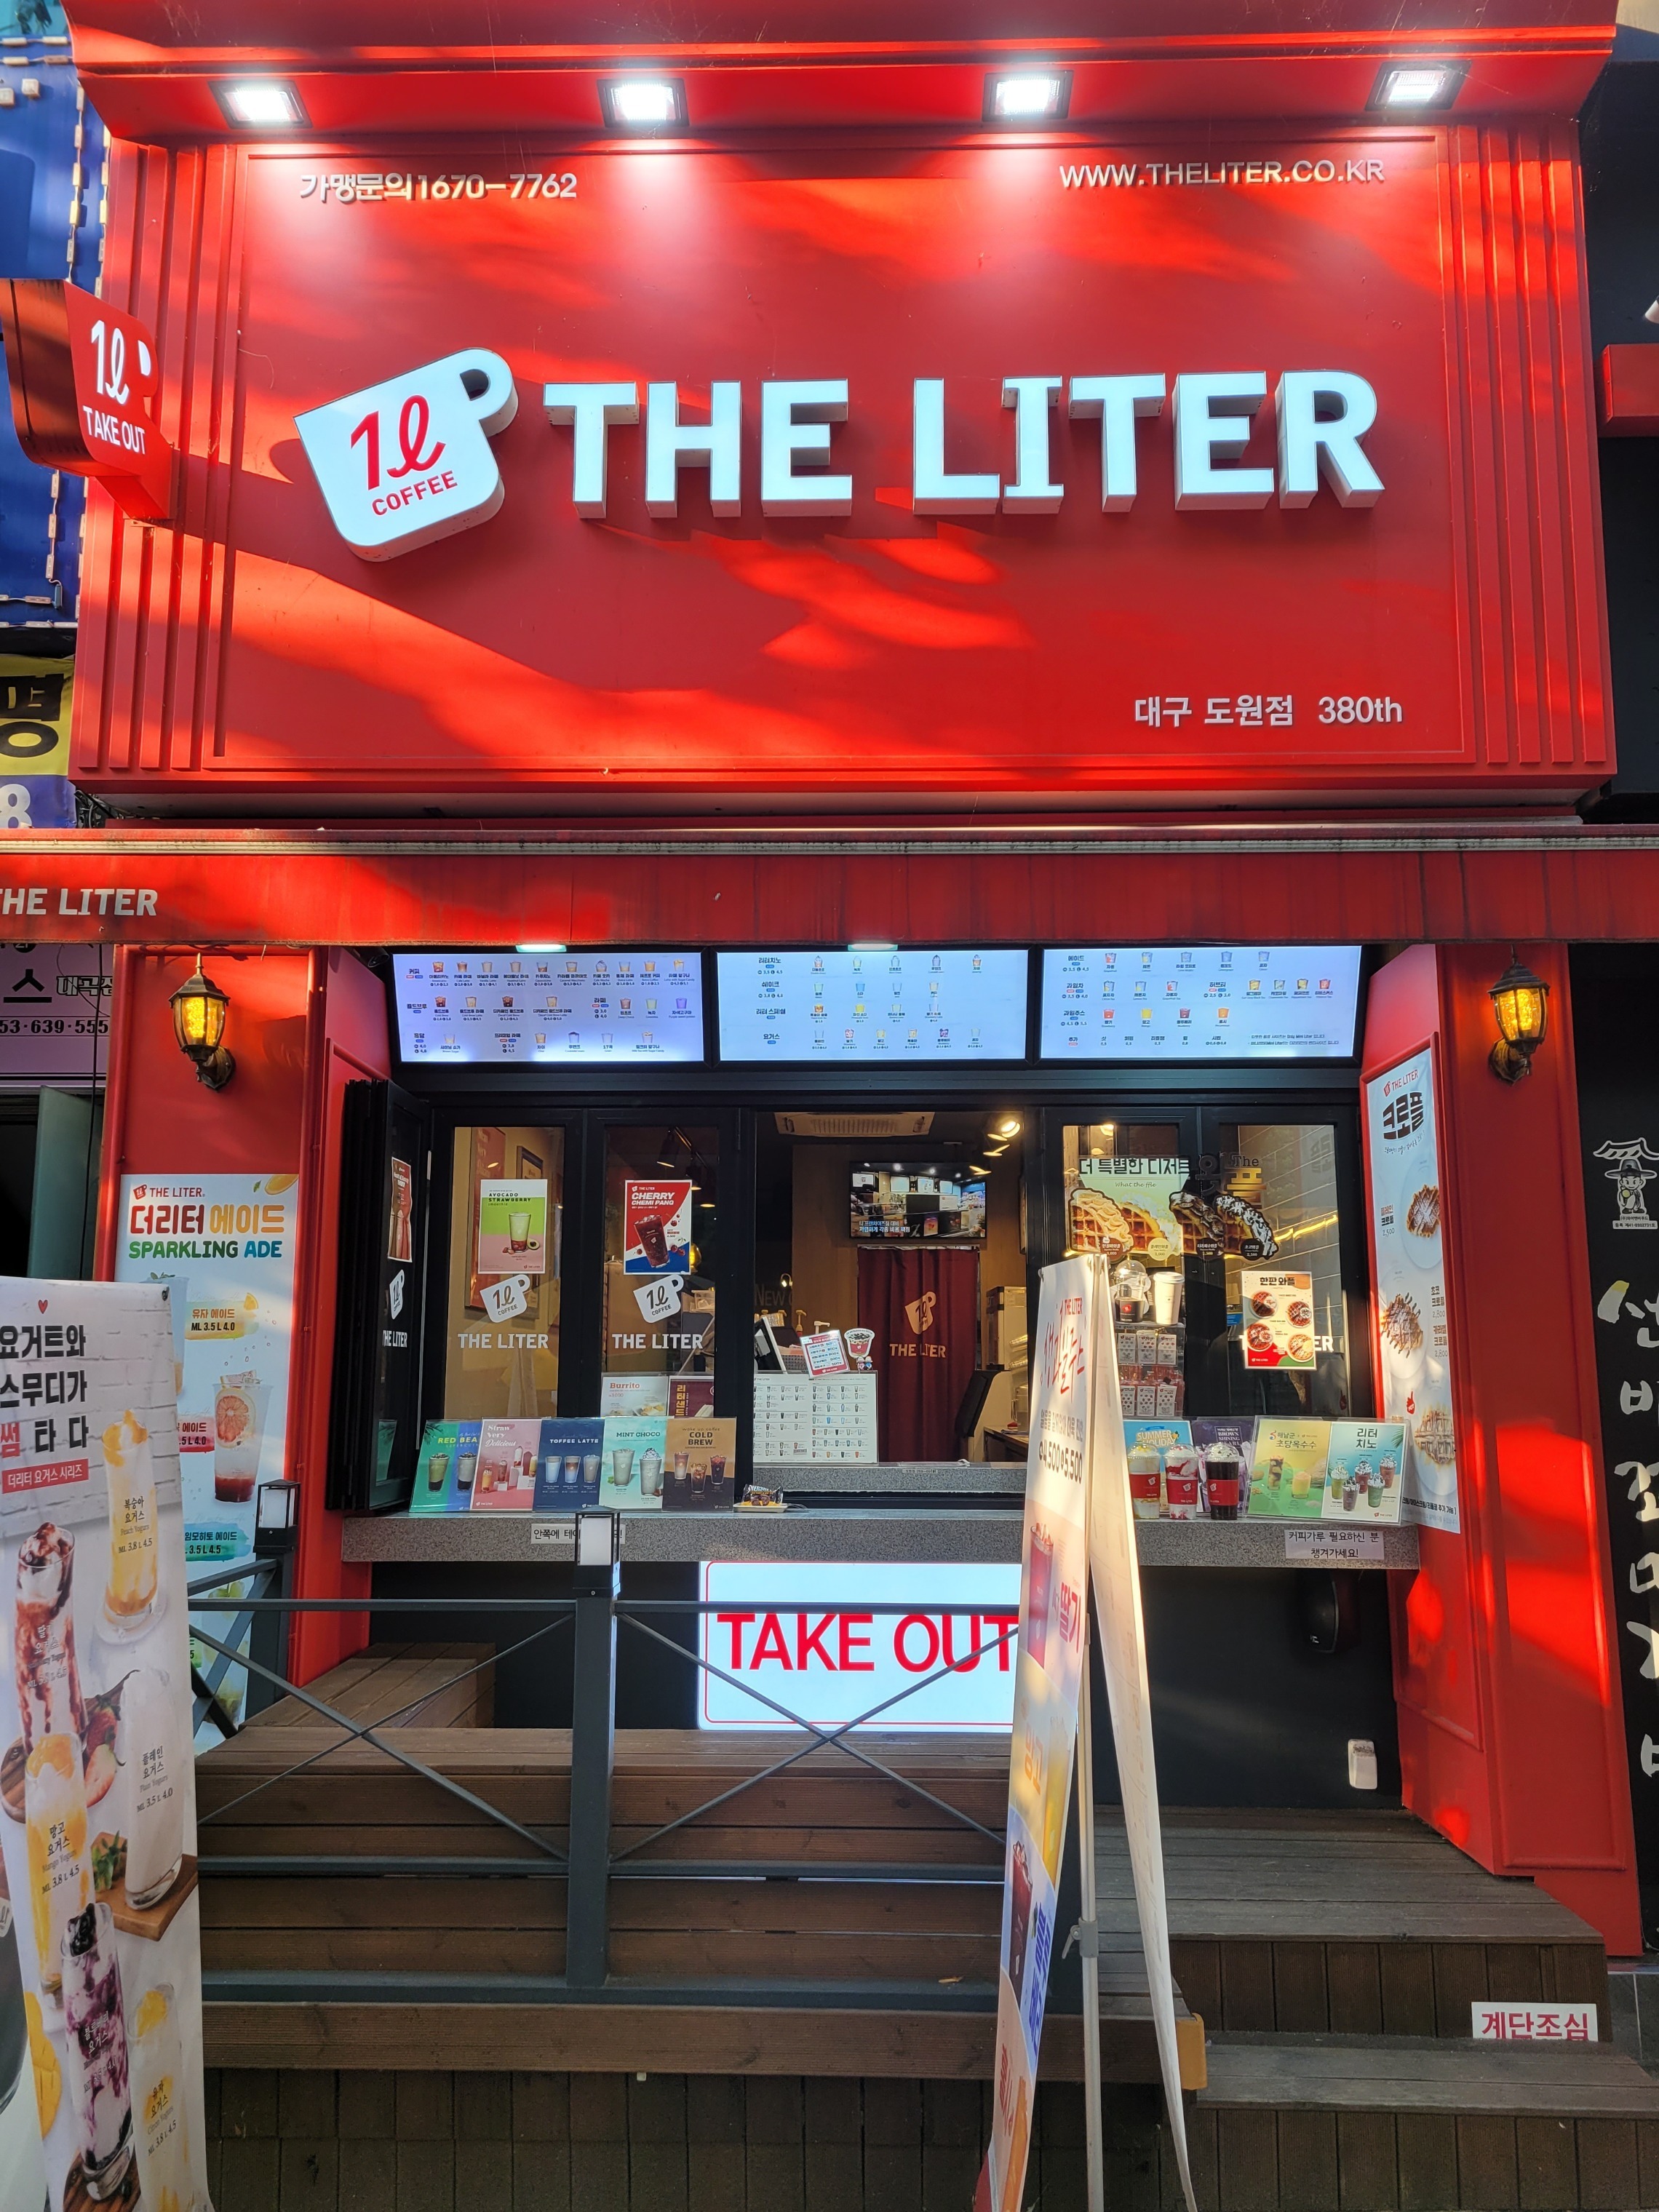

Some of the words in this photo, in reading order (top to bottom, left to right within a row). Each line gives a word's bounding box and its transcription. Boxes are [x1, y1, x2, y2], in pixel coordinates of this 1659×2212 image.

[1059, 159, 1385, 188] WWW.THELITER.CO.KR
[417, 173, 578, 200] 1670-7762
[83, 405, 121, 447] TAKE
[120, 419, 147, 456] OUT
[543, 377, 853, 517] THE
[912, 370, 1385, 514] LITER
[371, 470, 458, 517] COFFEE
[1135, 696, 1193, 728] 대구
[1204, 694, 1294, 727] 도원점
[1318, 696, 1403, 724] 380th
[0, 888, 48, 915] HE
[58, 888, 158, 917] LITER
[3, 968, 52, 1003] 스
[1391, 1078, 1402, 1091] THE
[1403, 1069, 1419, 1086] LITER
[1079, 1158, 1093, 1174] 더
[1098, 1158, 1143, 1174] 특별한
[1147, 1158, 1190, 1174] 디저트
[1233, 1155, 1260, 1167] The
[150, 1187, 170, 1198] THE
[172, 1187, 203, 1198] LITER
[631, 1192, 675, 1200] CHERRY
[130, 1204, 205, 1235] 더리터
[210, 1204, 285, 1235] 에이드
[128, 1240, 239, 1259] SPARKLING
[244, 1240, 283, 1258] ADE
[210, 1308, 235, 1318] 에이드
[498, 1303, 518, 1316] COFFEE
[651, 1303, 672, 1316] COFFEE
[191, 1323, 202, 1332] ML
[204, 1322, 215, 1331] 3.5
[217, 1323, 223, 1331] L
[223, 1322, 235, 1331] 4.0
[0, 1324, 87, 1359] 요거트와
[383, 1329, 393, 1347] THE
[393, 1329, 407, 1348] LITER
[458, 1333, 492, 1348] THE
[498, 1333, 549, 1349] LITER
[611, 1333, 646, 1349] THE
[652, 1333, 704, 1349] LITER
[889, 1343, 917, 1357] THE
[0, 1369, 88, 1408] 스무디가
[35, 1418, 57, 1454] 타
[69, 1415, 89, 1449] 다
[182, 1422, 207, 1433] 에이드
[488, 1431, 506, 1439] Very
[1137, 1430, 1172, 1441] SUMMER
[1356, 1428, 1378, 1439] 리터
[194, 1436, 207, 1445] 4.0
[485, 1439, 517, 1447] Delicious
[1276, 1440, 1317, 1449] 초당옥수수
[1356, 1439, 1377, 1449] 치노
[8, 1471, 33, 1489] 더리터
[34, 1468, 59, 1485] 요거스
[60, 1463, 83, 1481] 시리즈
[124, 1495, 145, 1509] 복숭아
[124, 1509, 146, 1524] 요거스
[184, 1531, 213, 1542] 임모히토
[215, 1531, 238, 1542] 에이드
[533, 1529, 560, 1540] 안쪽에
[1289, 1531, 1326, 1542] 커피가루
[1329, 1531, 1366, 1542] 필요하신
[1369, 1532, 1380, 1543] 분
[189, 1545, 202, 1555] 3.5
[208, 1545, 221, 1555] 4.5
[1310, 1548, 1359, 1559] 챙겨가세요!
[717, 1613, 875, 1671] TAKE
[894, 1614, 1019, 1673] OUT
[142, 1745, 164, 1765] 플레인
[143, 1763, 164, 1780] 요거스
[49, 1821, 65, 1839] 망고
[47, 1836, 70, 1857] 요거스
[1481, 2011, 1588, 2041] 계단조심
[151, 2080, 164, 2099] 유자
[150, 2094, 168, 2118] 요거스
